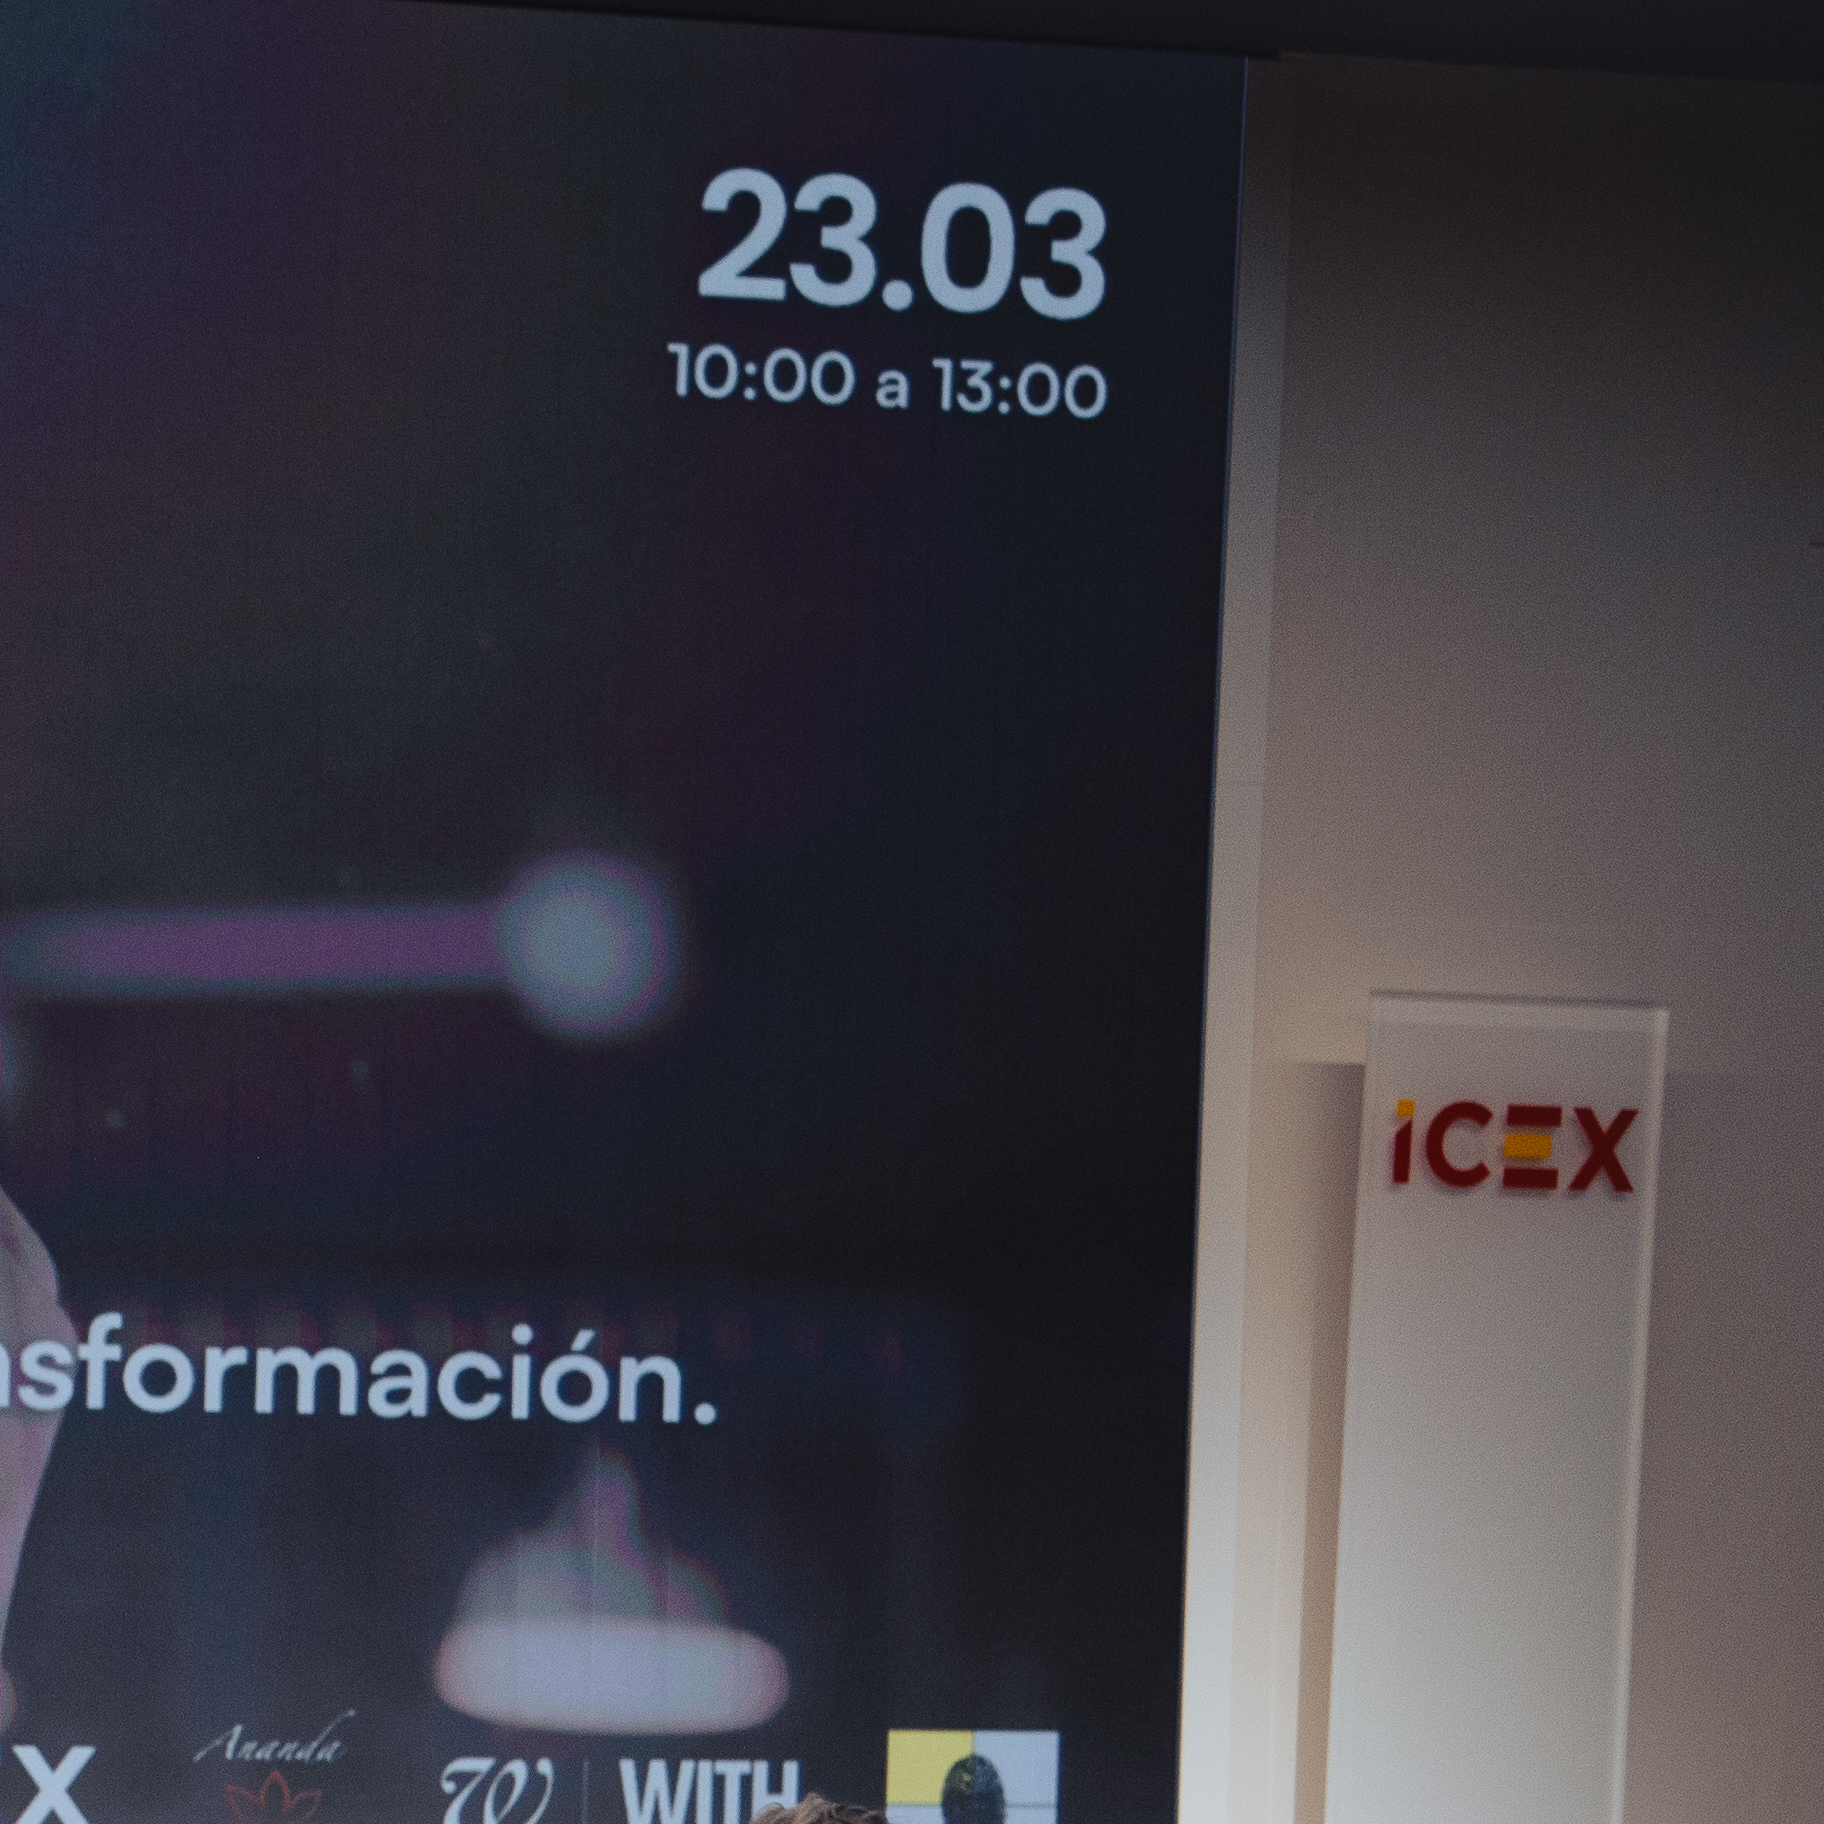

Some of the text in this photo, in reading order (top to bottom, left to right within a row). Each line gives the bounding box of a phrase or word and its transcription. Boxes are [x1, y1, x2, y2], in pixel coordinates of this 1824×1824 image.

[697, 167, 1107, 320] 23.03
[667, 342, 1108, 419] 10:00 a 13:00
